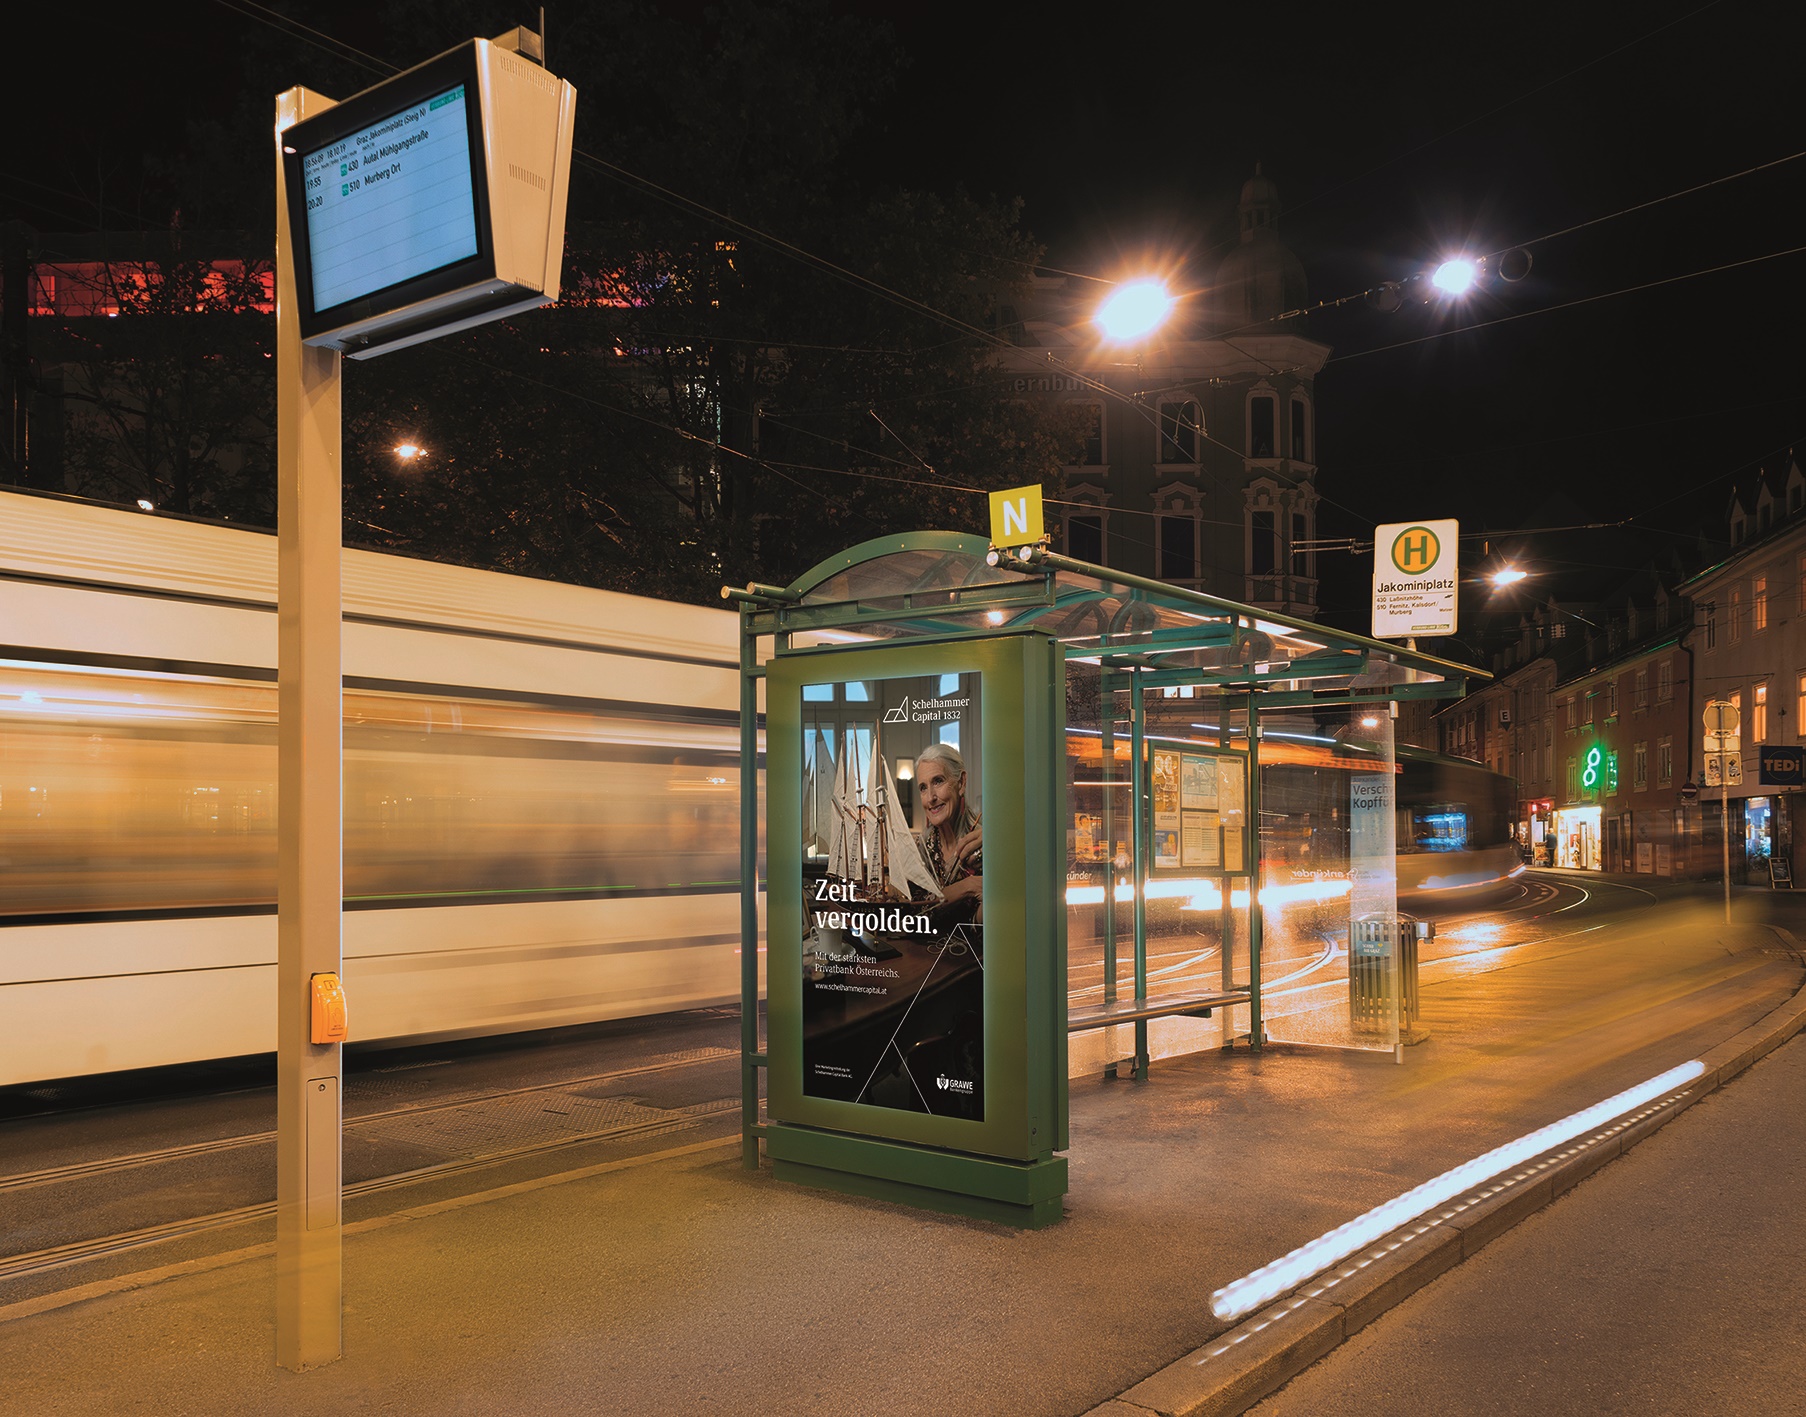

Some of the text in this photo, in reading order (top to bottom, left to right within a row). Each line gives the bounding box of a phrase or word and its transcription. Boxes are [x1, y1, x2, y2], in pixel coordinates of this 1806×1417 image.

[356, 135, 368, 146] Graz
[369, 119, 403, 141] Jakominiplatz
[404, 112, 419, 125] (Steig
[419, 107, 427, 117] N)
[348, 159, 359, 171] 430
[363, 150, 379, 166] Autal
[380, 130, 429, 158] Mühlgangstraße
[349, 179, 361, 192] 510
[364, 168, 390, 186] Murberg
[391, 162, 402, 175] Ort
[1003, 497, 1028, 536] N
[1404, 535, 1427, 565] H
[1377, 579, 1454, 593] Jakominiplatz
[912, 698, 970, 710] Schelhammer
[912, 710, 961, 723] Capital 1832
[1502, 712, 1509, 720] E
[1764, 759, 1799, 772] TEDi
[815, 879, 857, 902] Zeit
[815, 907, 938, 937] vergolden.
[815, 952, 877, 964] Mit der stärksten
[815, 963, 900, 978] Privatbank Österreichs.
[815, 982, 887, 995] www.schelhammercapital.at
[949, 1079, 973, 1090] GRAWE
